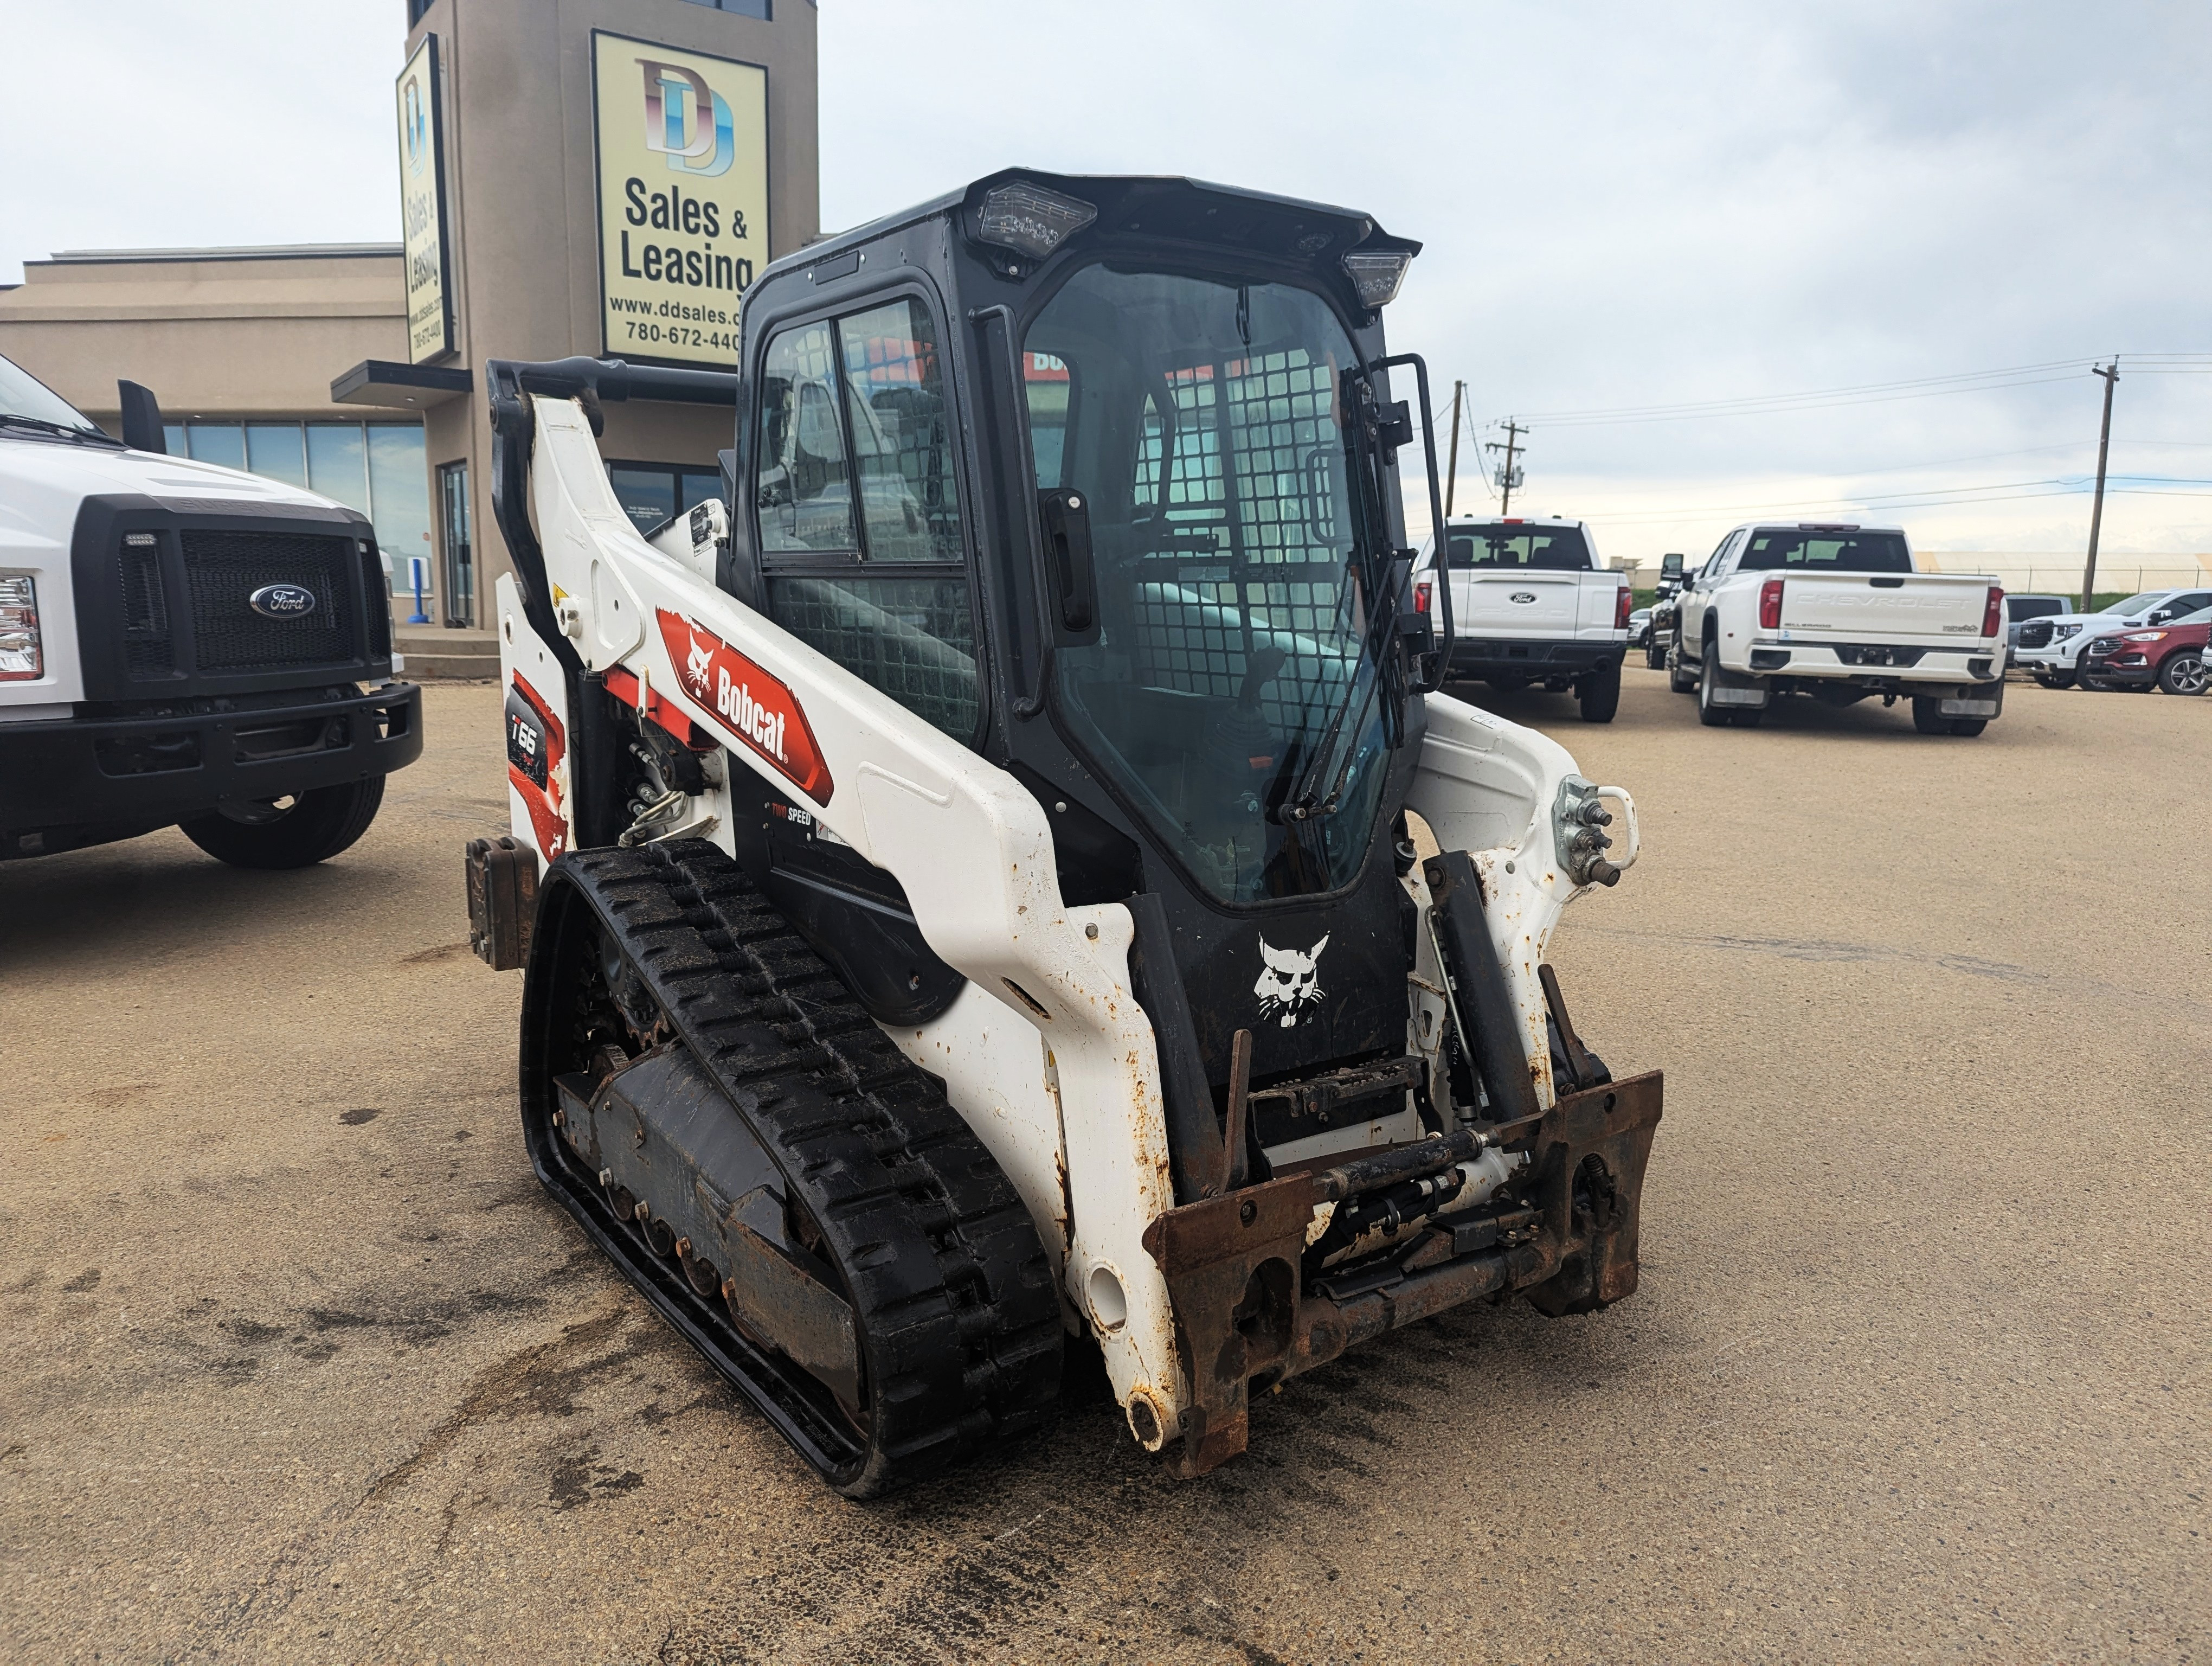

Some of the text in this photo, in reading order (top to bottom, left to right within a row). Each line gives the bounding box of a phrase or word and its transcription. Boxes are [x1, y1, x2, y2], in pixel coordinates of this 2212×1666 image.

[625, 177, 748, 240] Sales &
[621, 230, 753, 302] Leasing
[270, 590, 304, 610] Ford
[1514, 593, 1532, 603] Ford
[1796, 594, 1973, 610] CHEVROLET
[717, 665, 786, 761] Bobcat
[512, 713, 537, 755] T66
[771, 803, 811, 825] TWO SPEED
